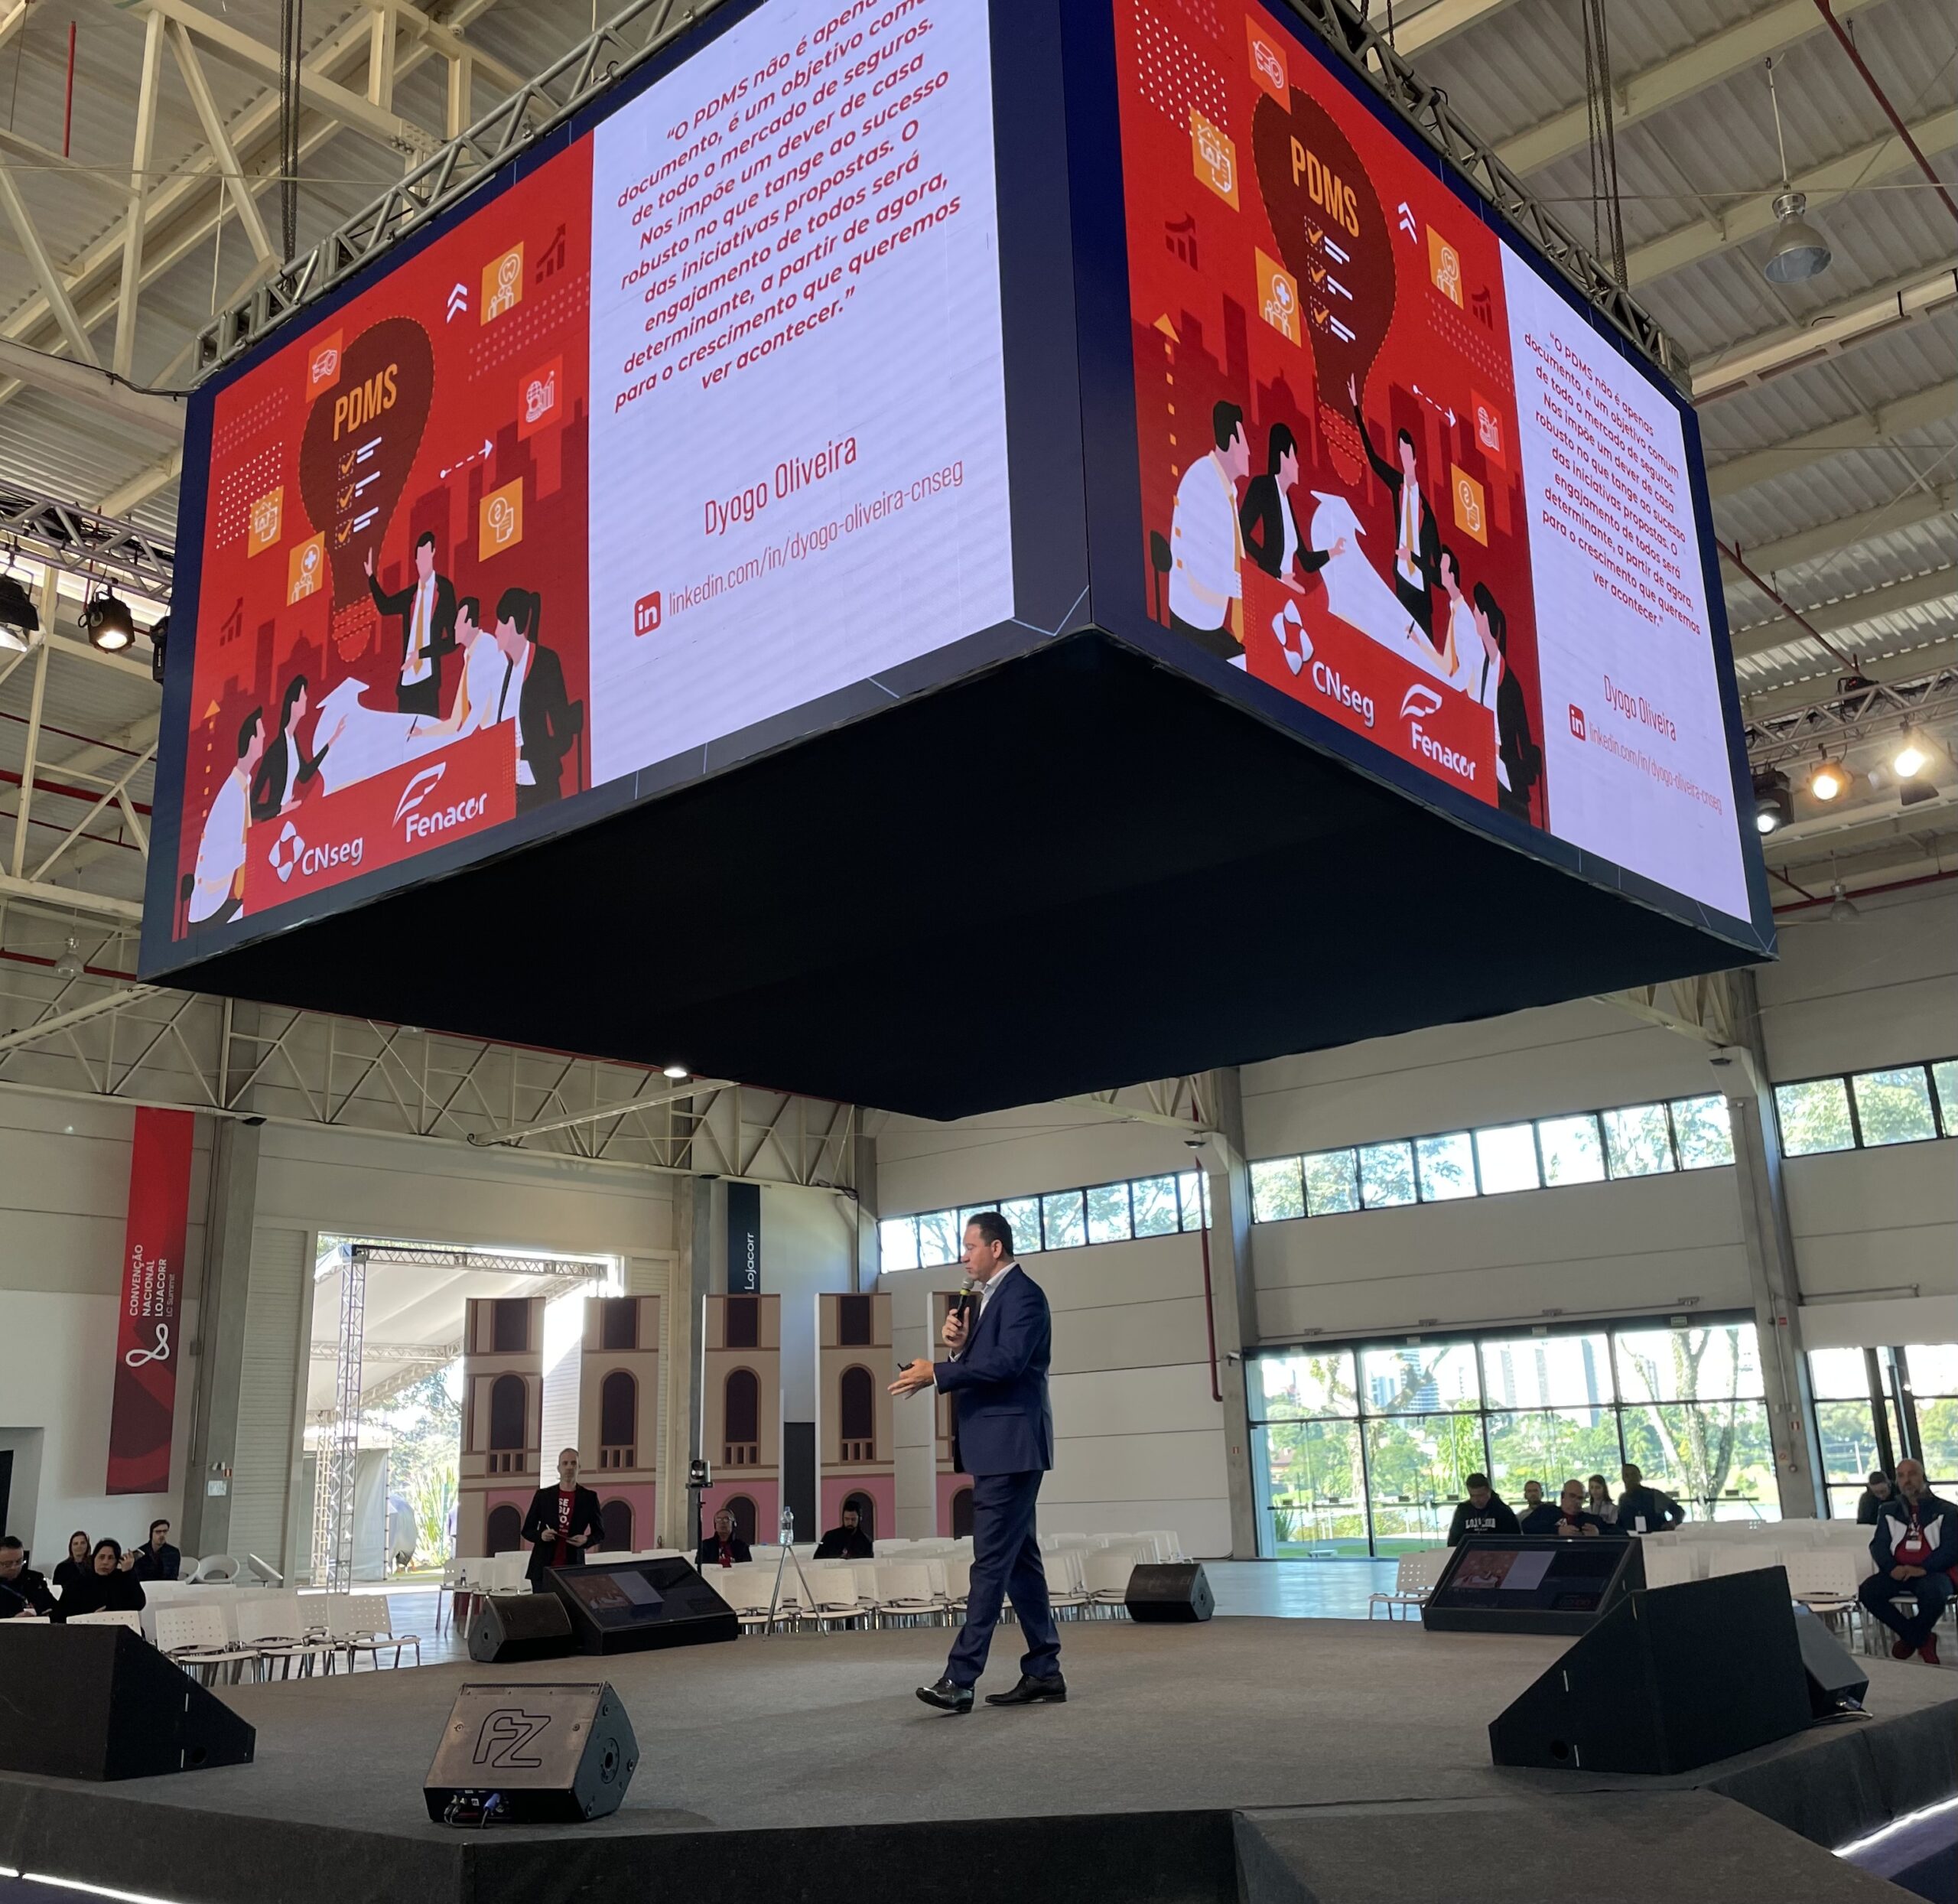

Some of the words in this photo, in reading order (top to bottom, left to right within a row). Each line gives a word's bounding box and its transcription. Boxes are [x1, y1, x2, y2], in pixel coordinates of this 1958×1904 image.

[618, 132, 722, 207] documento,
[729, 117, 739, 132] é
[746, 92, 775, 122] um
[782, 33, 863, 96] objetivo
[633, 204, 653, 226] de
[659, 174, 699, 208] todo
[704, 163, 715, 178] o
[720, 102, 807, 168] mercado
[813, 80, 838, 106] de
[844, 18, 932, 86] seguros.
[667, 121, 688, 140] “O
[694, 77, 748, 130] PDMS
[753, 54, 790, 88] não
[796, 41, 807, 57] é
[622, 238, 689, 290] robusto
[694, 220, 717, 244] no
[723, 193, 759, 226] que
[765, 151, 824, 197] tange
[830, 131, 856, 156] ao
[862, 72, 948, 137] sucesso
[640, 218, 672, 249] Nos
[678, 179, 735, 225] impõe
[742, 155, 771, 183] um
[778, 111, 835, 159] dever
[841, 93, 866, 118] de
[873, 54, 923, 96] casa
[1290, 135, 1359, 238] PDMS
[645, 274, 677, 303] das
[681, 210, 779, 282] iniciativas
[784, 140, 894, 223] propostas.
[902, 120, 918, 142] O
[646, 247, 771, 332] engajamento
[777, 228, 802, 252] de
[808, 187, 866, 234] todos
[872, 155, 919, 195] será
[616, 373, 657, 413] para
[662, 365, 672, 380] o
[678, 294, 797, 371] crescimento
[803, 267, 842, 301] que
[849, 197, 960, 275] queremos
[624, 289, 754, 373] determinante,
[761, 274, 773, 292] a
[779, 236, 838, 288] partir
[844, 218, 870, 242] de
[877, 173, 947, 223] agora,
[702, 361, 732, 389] ver
[737, 285, 854, 369] acontecer.”
[1550, 332, 1562, 353] “O
[1565, 346, 1592, 381] PDMS
[1595, 376, 1612, 399] não
[1615, 393, 1620, 406] é
[1622, 402, 1654, 437] apenas
[333, 363, 398, 441] PDMS
[1525, 334, 1583, 396] documento,
[1586, 387, 1591, 401] é
[1594, 395, 1608, 416] um
[1611, 412, 1646, 449] objetivo
[1648, 445, 1679, 480] comum
[1536, 366, 1548, 385] de
[1551, 377, 1573, 406] todo
[1576, 402, 1582, 414] o
[1585, 408, 1625, 451] mercado
[1628, 445, 1638, 463] de
[1641, 458, 1676, 496] seguros.
[1544, 392, 1563, 419] Nos
[1565, 409, 1595, 447] impõe
[1597, 441, 1612, 462] um
[1615, 456, 1639, 483] dever
[1642, 479, 1652, 496] de
[1654, 490, 1673, 514] casa
[704, 482, 767, 535] Dyogo
[775, 436, 857, 500] Oliveira
[1536, 411, 1574, 451] robusto
[1576, 444, 1589, 463] no
[1592, 458, 1609, 480] que
[1612, 472, 1638, 504] tange
[1640, 499, 1651, 515] ao
[1653, 509, 1685, 542] sucesso
[1552, 447, 1570, 470] das
[1573, 461, 1622, 512] iniciativas
[1623, 505, 1669, 550] propostas.
[1671, 542, 1677, 556] O
[1555, 474, 1620, 532] engajamento
[1622, 525, 1634, 543] de
[1636, 535, 1660, 563] todos
[1663, 558, 1680, 580] será
[668, 460, 964, 617] linkedin.com/in/dyogo-oliveira-cnseg
[1543, 509, 1566, 536] para
[1569, 531, 1576, 542] o
[1579, 538, 1637, 588] crescimento
[1640, 584, 1656, 603] que
[1658, 599, 1700, 635] queremos
[1545, 487, 1615, 553] determinante,
[1618, 545, 1624, 557] a
[1626, 549, 1651, 578] partir
[1654, 571, 1664, 587] de
[1667, 582, 1693, 612] agora,
[1593, 571, 1608, 590] ver
[1612, 586, 1663, 627] acontecer.”
[1312, 660, 1374, 727] CNseg
[1604, 674, 1637, 719] Dyogo
[1639, 697, 1677, 741] Oliveira
[1411, 721, 1476, 780] Fenacor
[301, 837, 363, 876] CNseg
[406, 793, 487, 842] Fenacor
[129, 1244, 145, 1317] CONVENÇÃO
[142, 1259, 155, 1317] NACIONAL
[154, 1258, 167, 1317] LOJACORR
[744, 1232, 756, 1290] Lojacorr
